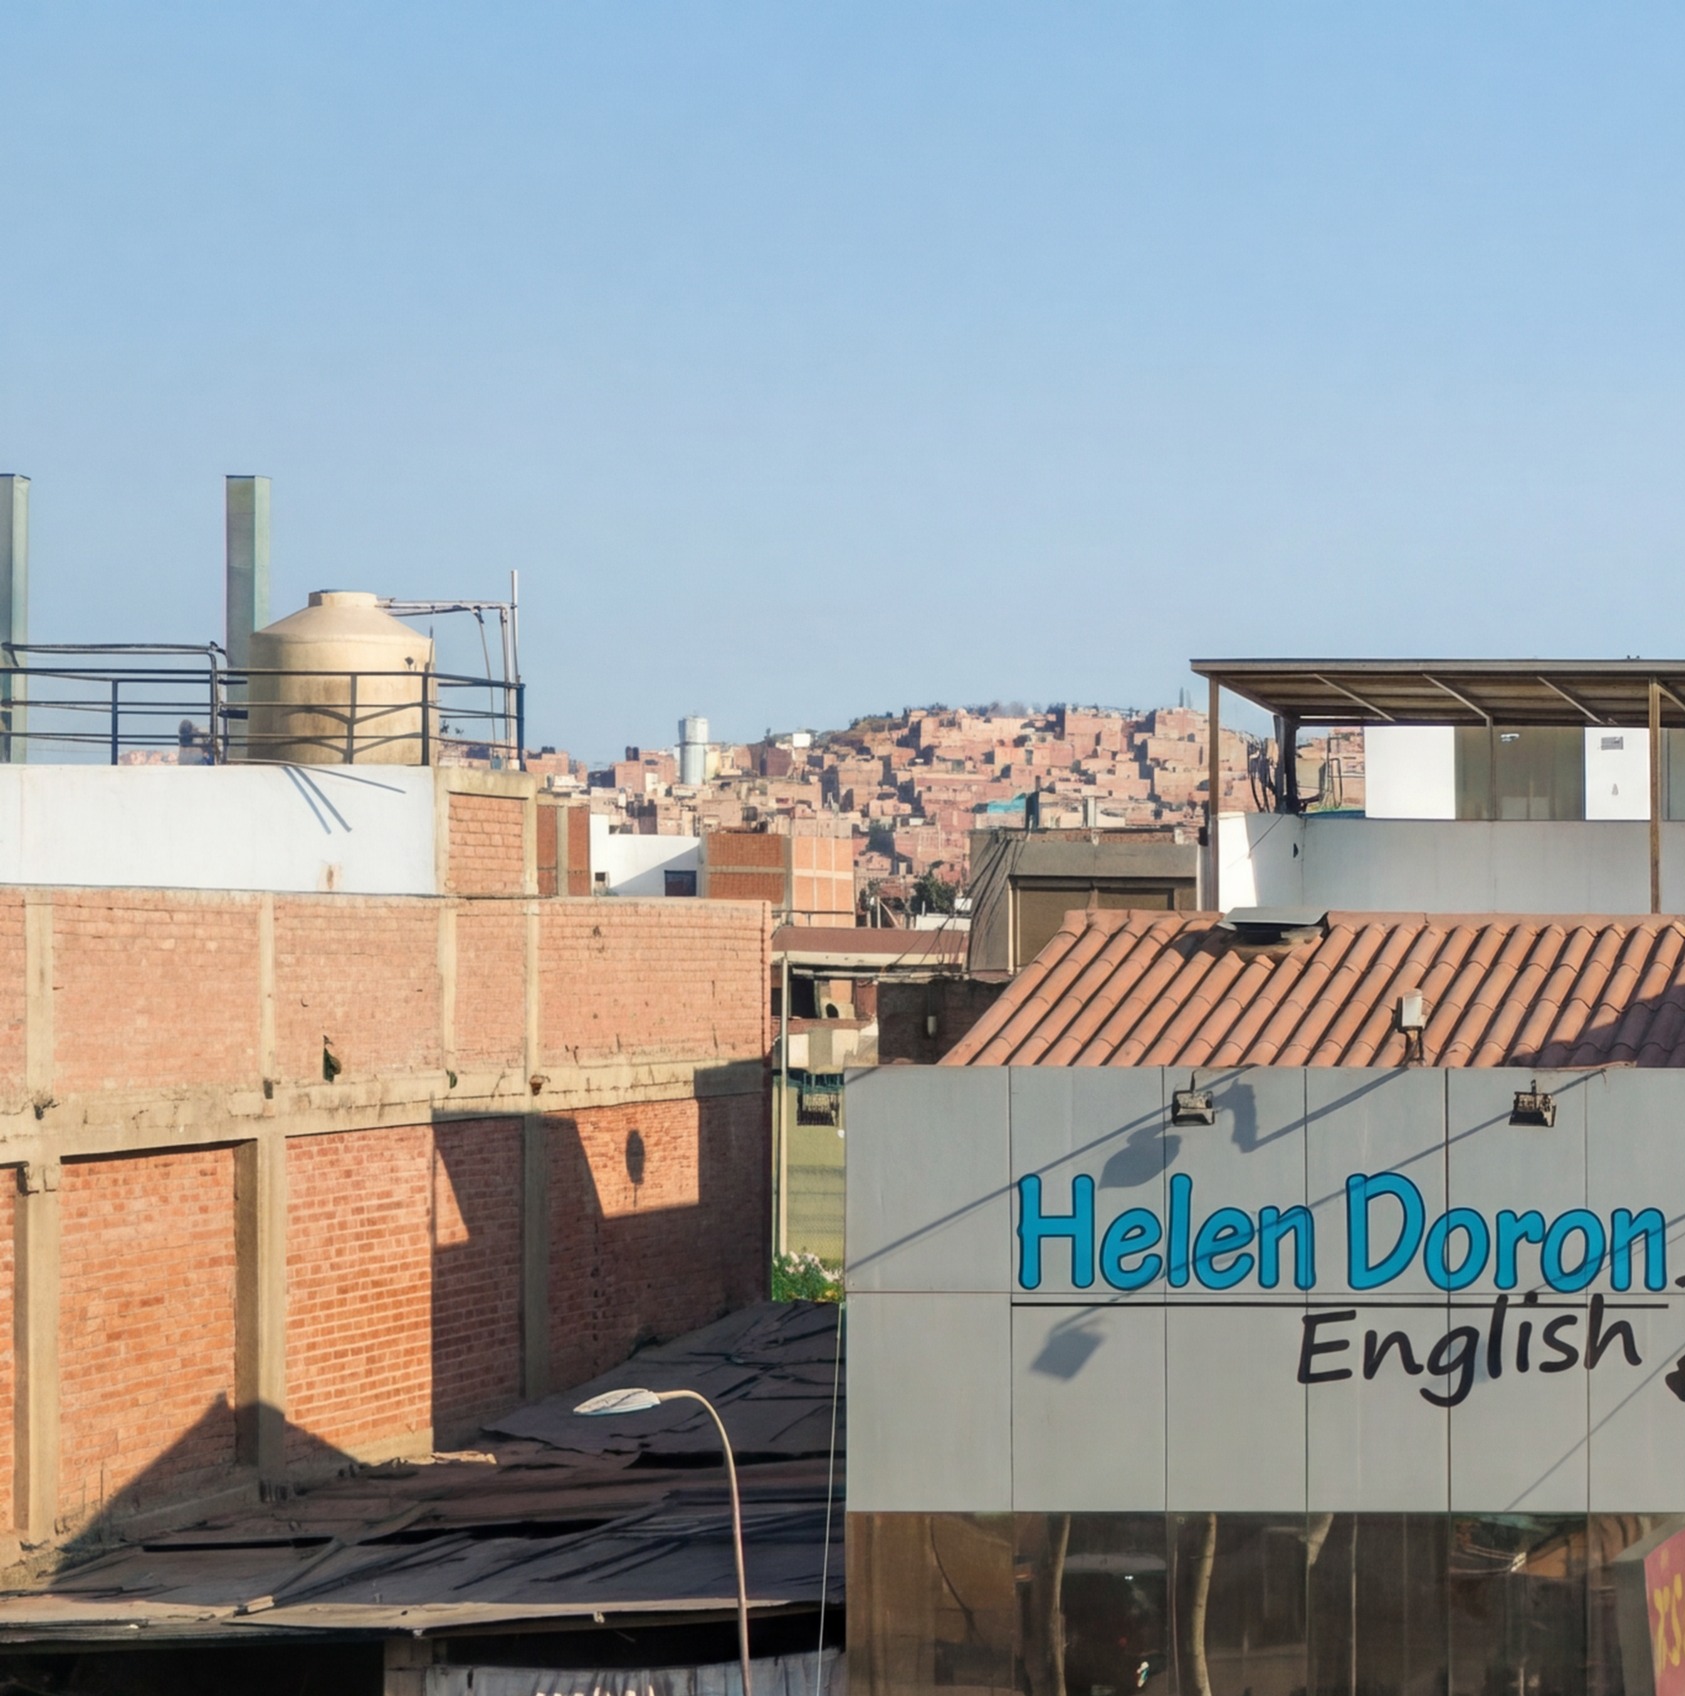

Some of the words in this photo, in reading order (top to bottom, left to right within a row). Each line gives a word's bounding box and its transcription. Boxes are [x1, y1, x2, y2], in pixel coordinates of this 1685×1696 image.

[1017, 1172, 1315, 1291] Helen
[1345, 1172, 1668, 1292] Doron
[1297, 1292, 1643, 1407] English
